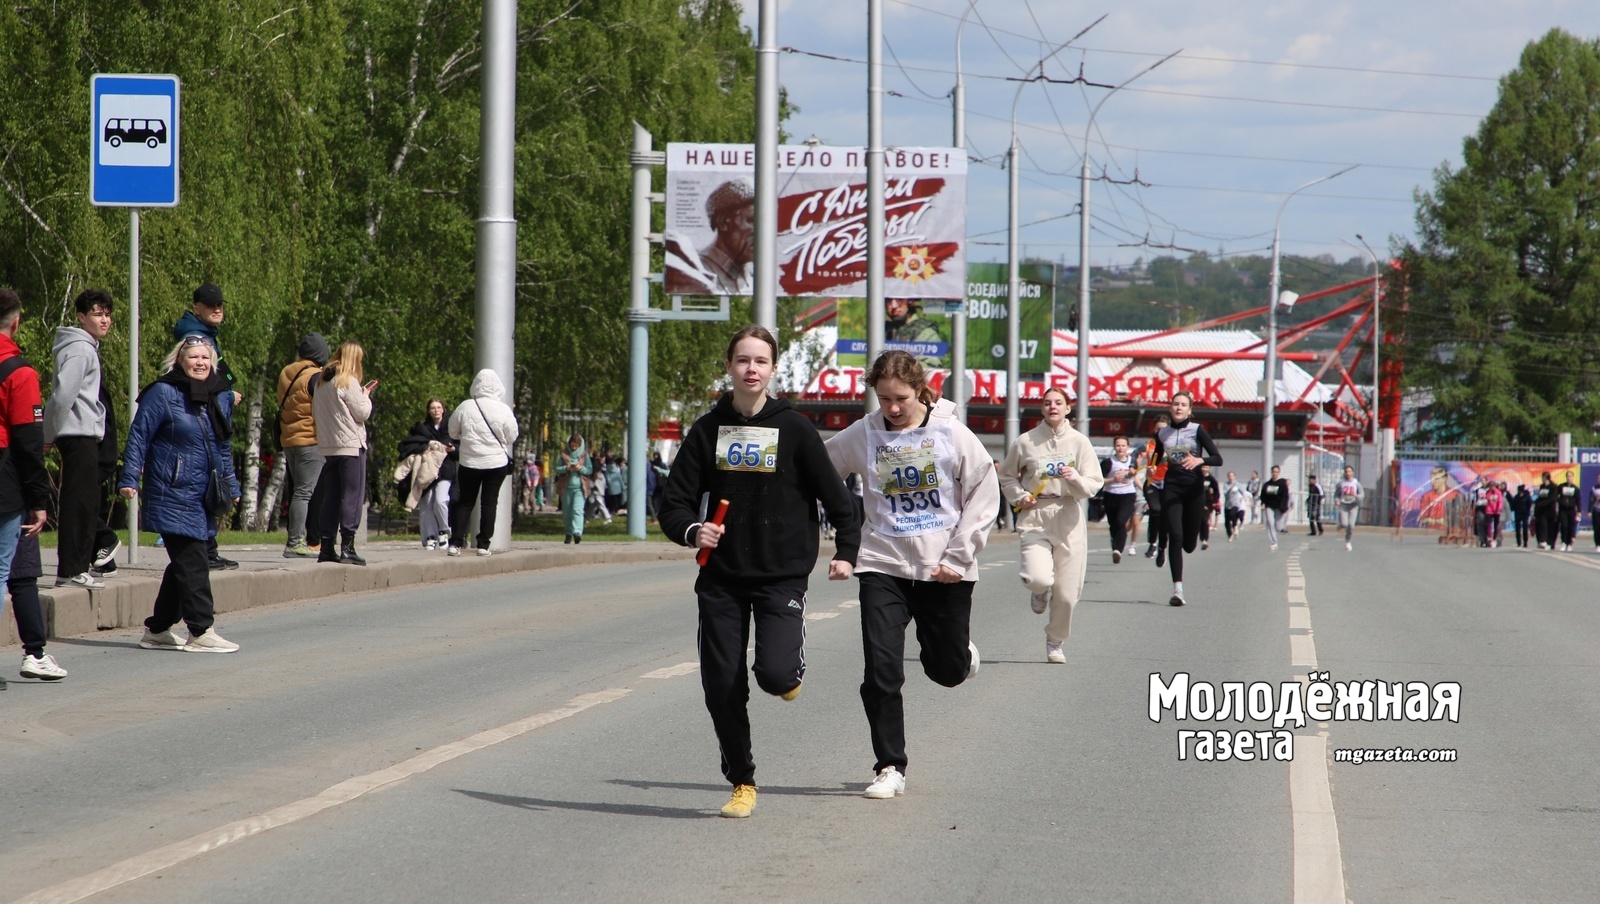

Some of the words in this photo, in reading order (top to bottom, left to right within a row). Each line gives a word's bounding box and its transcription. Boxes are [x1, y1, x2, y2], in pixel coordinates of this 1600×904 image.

[686, 150, 754, 166] НАШЕ
[777, 151, 831, 168] ЕЛО
[846, 151, 949, 168] ПВОЕ!
[791, 191, 824, 236] С
[783, 203, 931, 282] Побеы!
[727, 442, 760, 467] 65
[766, 455, 774, 467] 8
[1581, 452, 1600, 464] ВС
[892, 465, 920, 489] 19
[927, 474, 936, 484] 8
[885, 489, 942, 514] 1530
[892, 520, 944, 532] БАШКОРТОСТАН
[896, 513, 937, 524] РЕСПУБЛИКА
